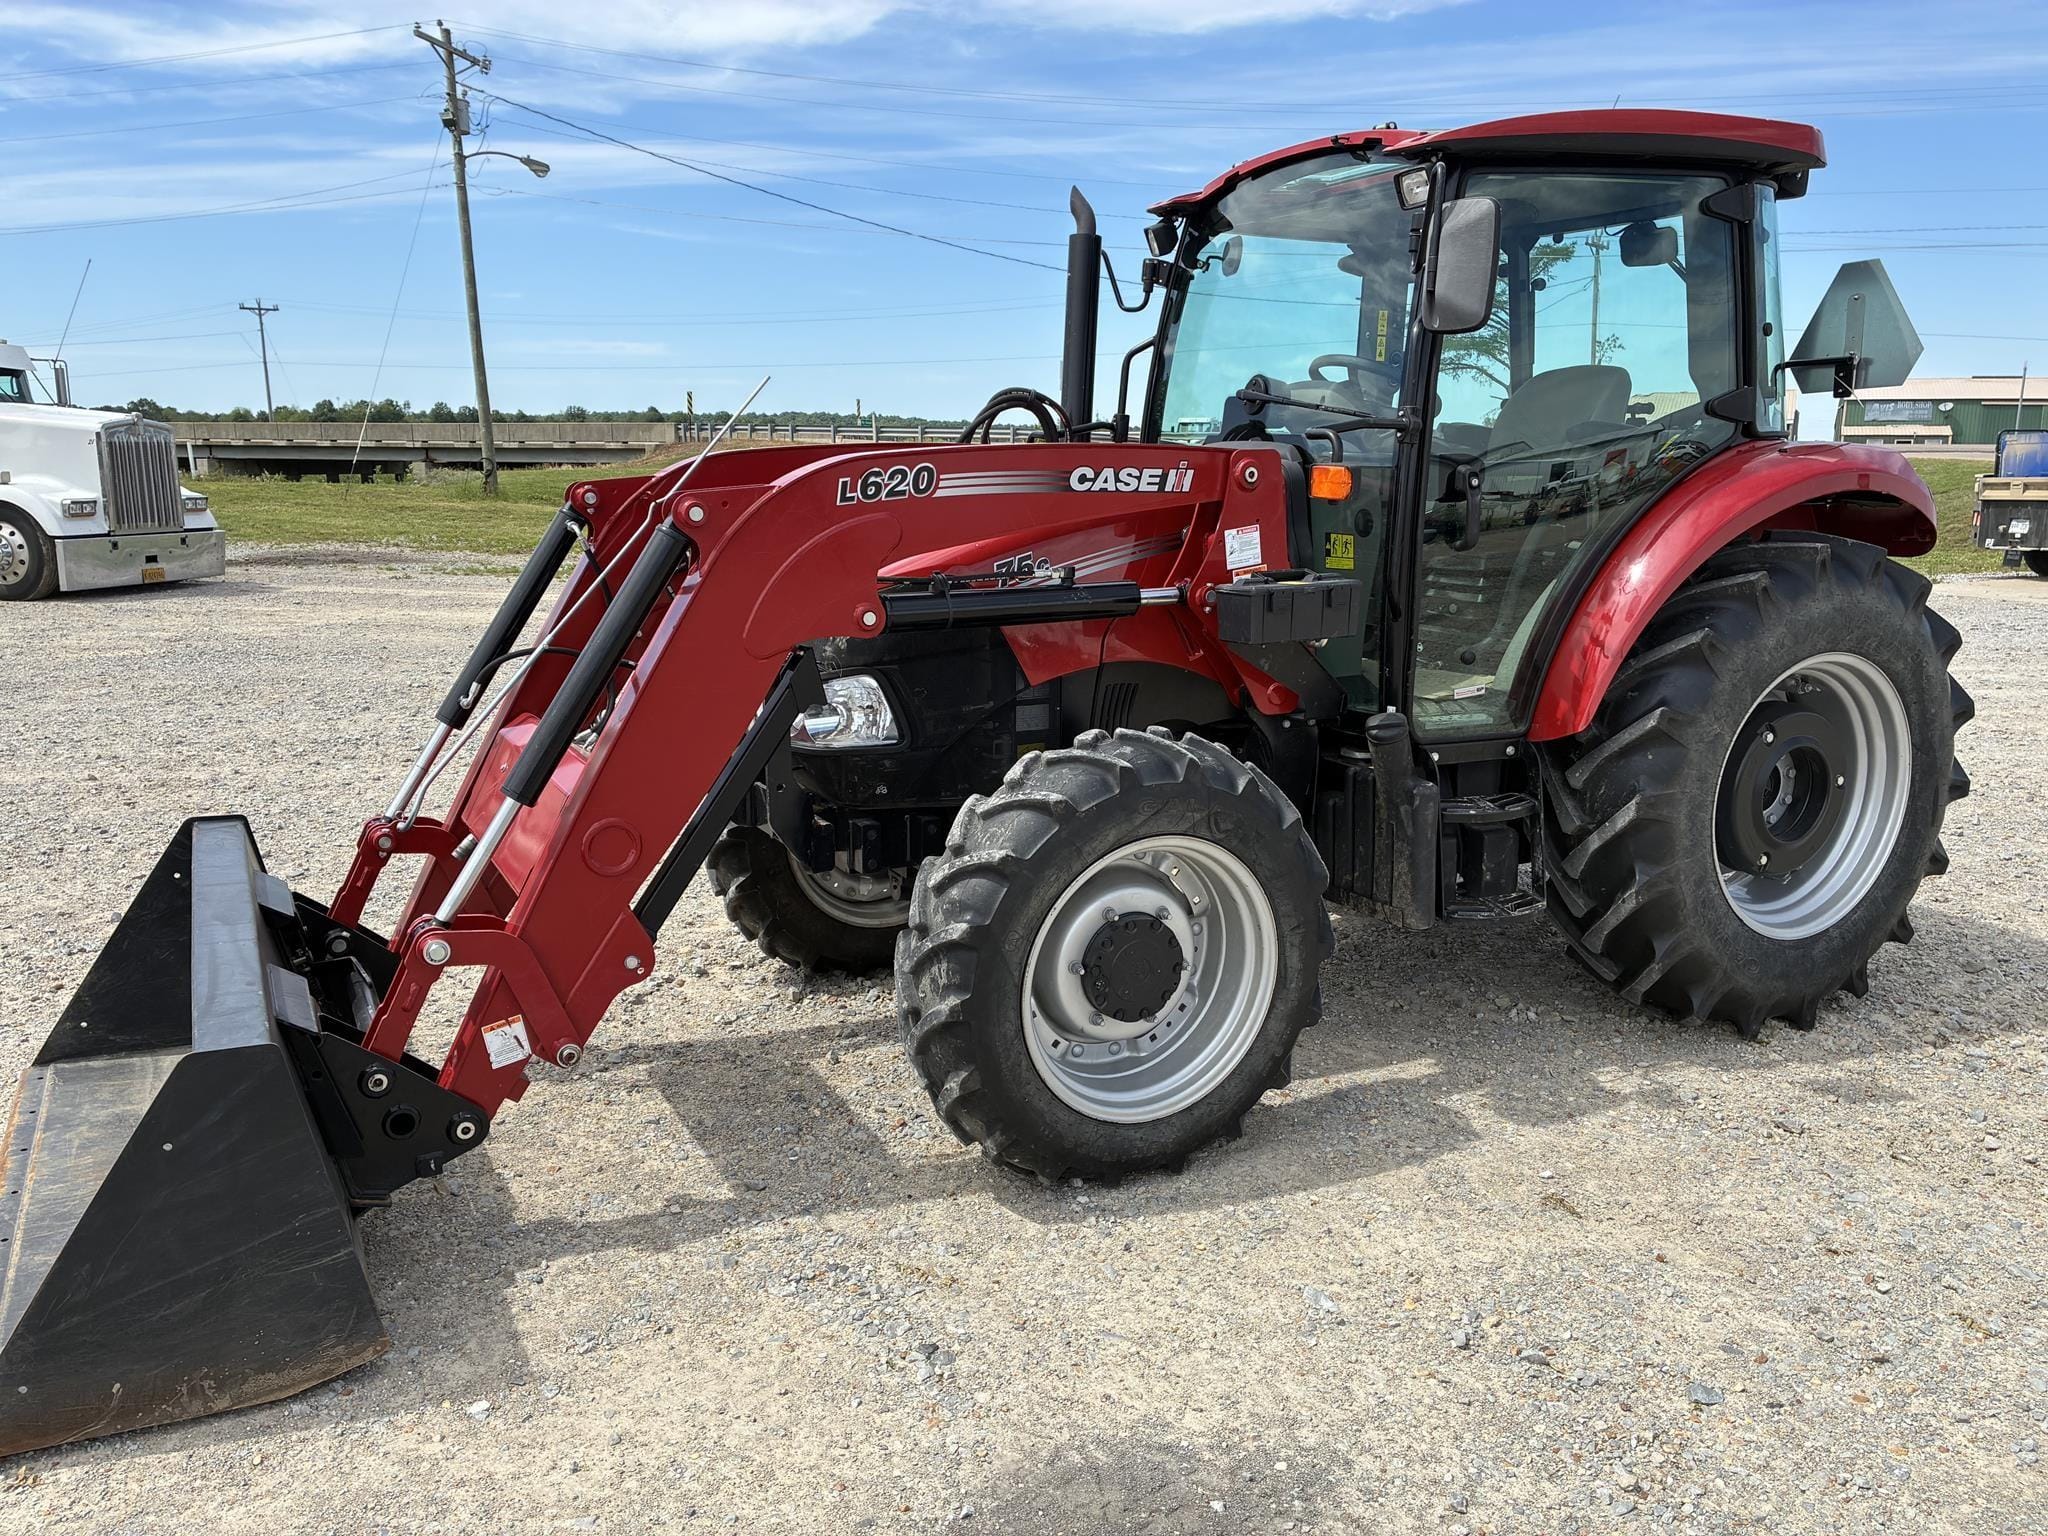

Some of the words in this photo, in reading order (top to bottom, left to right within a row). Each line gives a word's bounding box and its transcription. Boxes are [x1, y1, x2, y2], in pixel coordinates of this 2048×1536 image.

[1915, 400, 1932, 409] SHOP
[836, 462, 937, 506] L620
[1069, 466, 1163, 492] CASE
